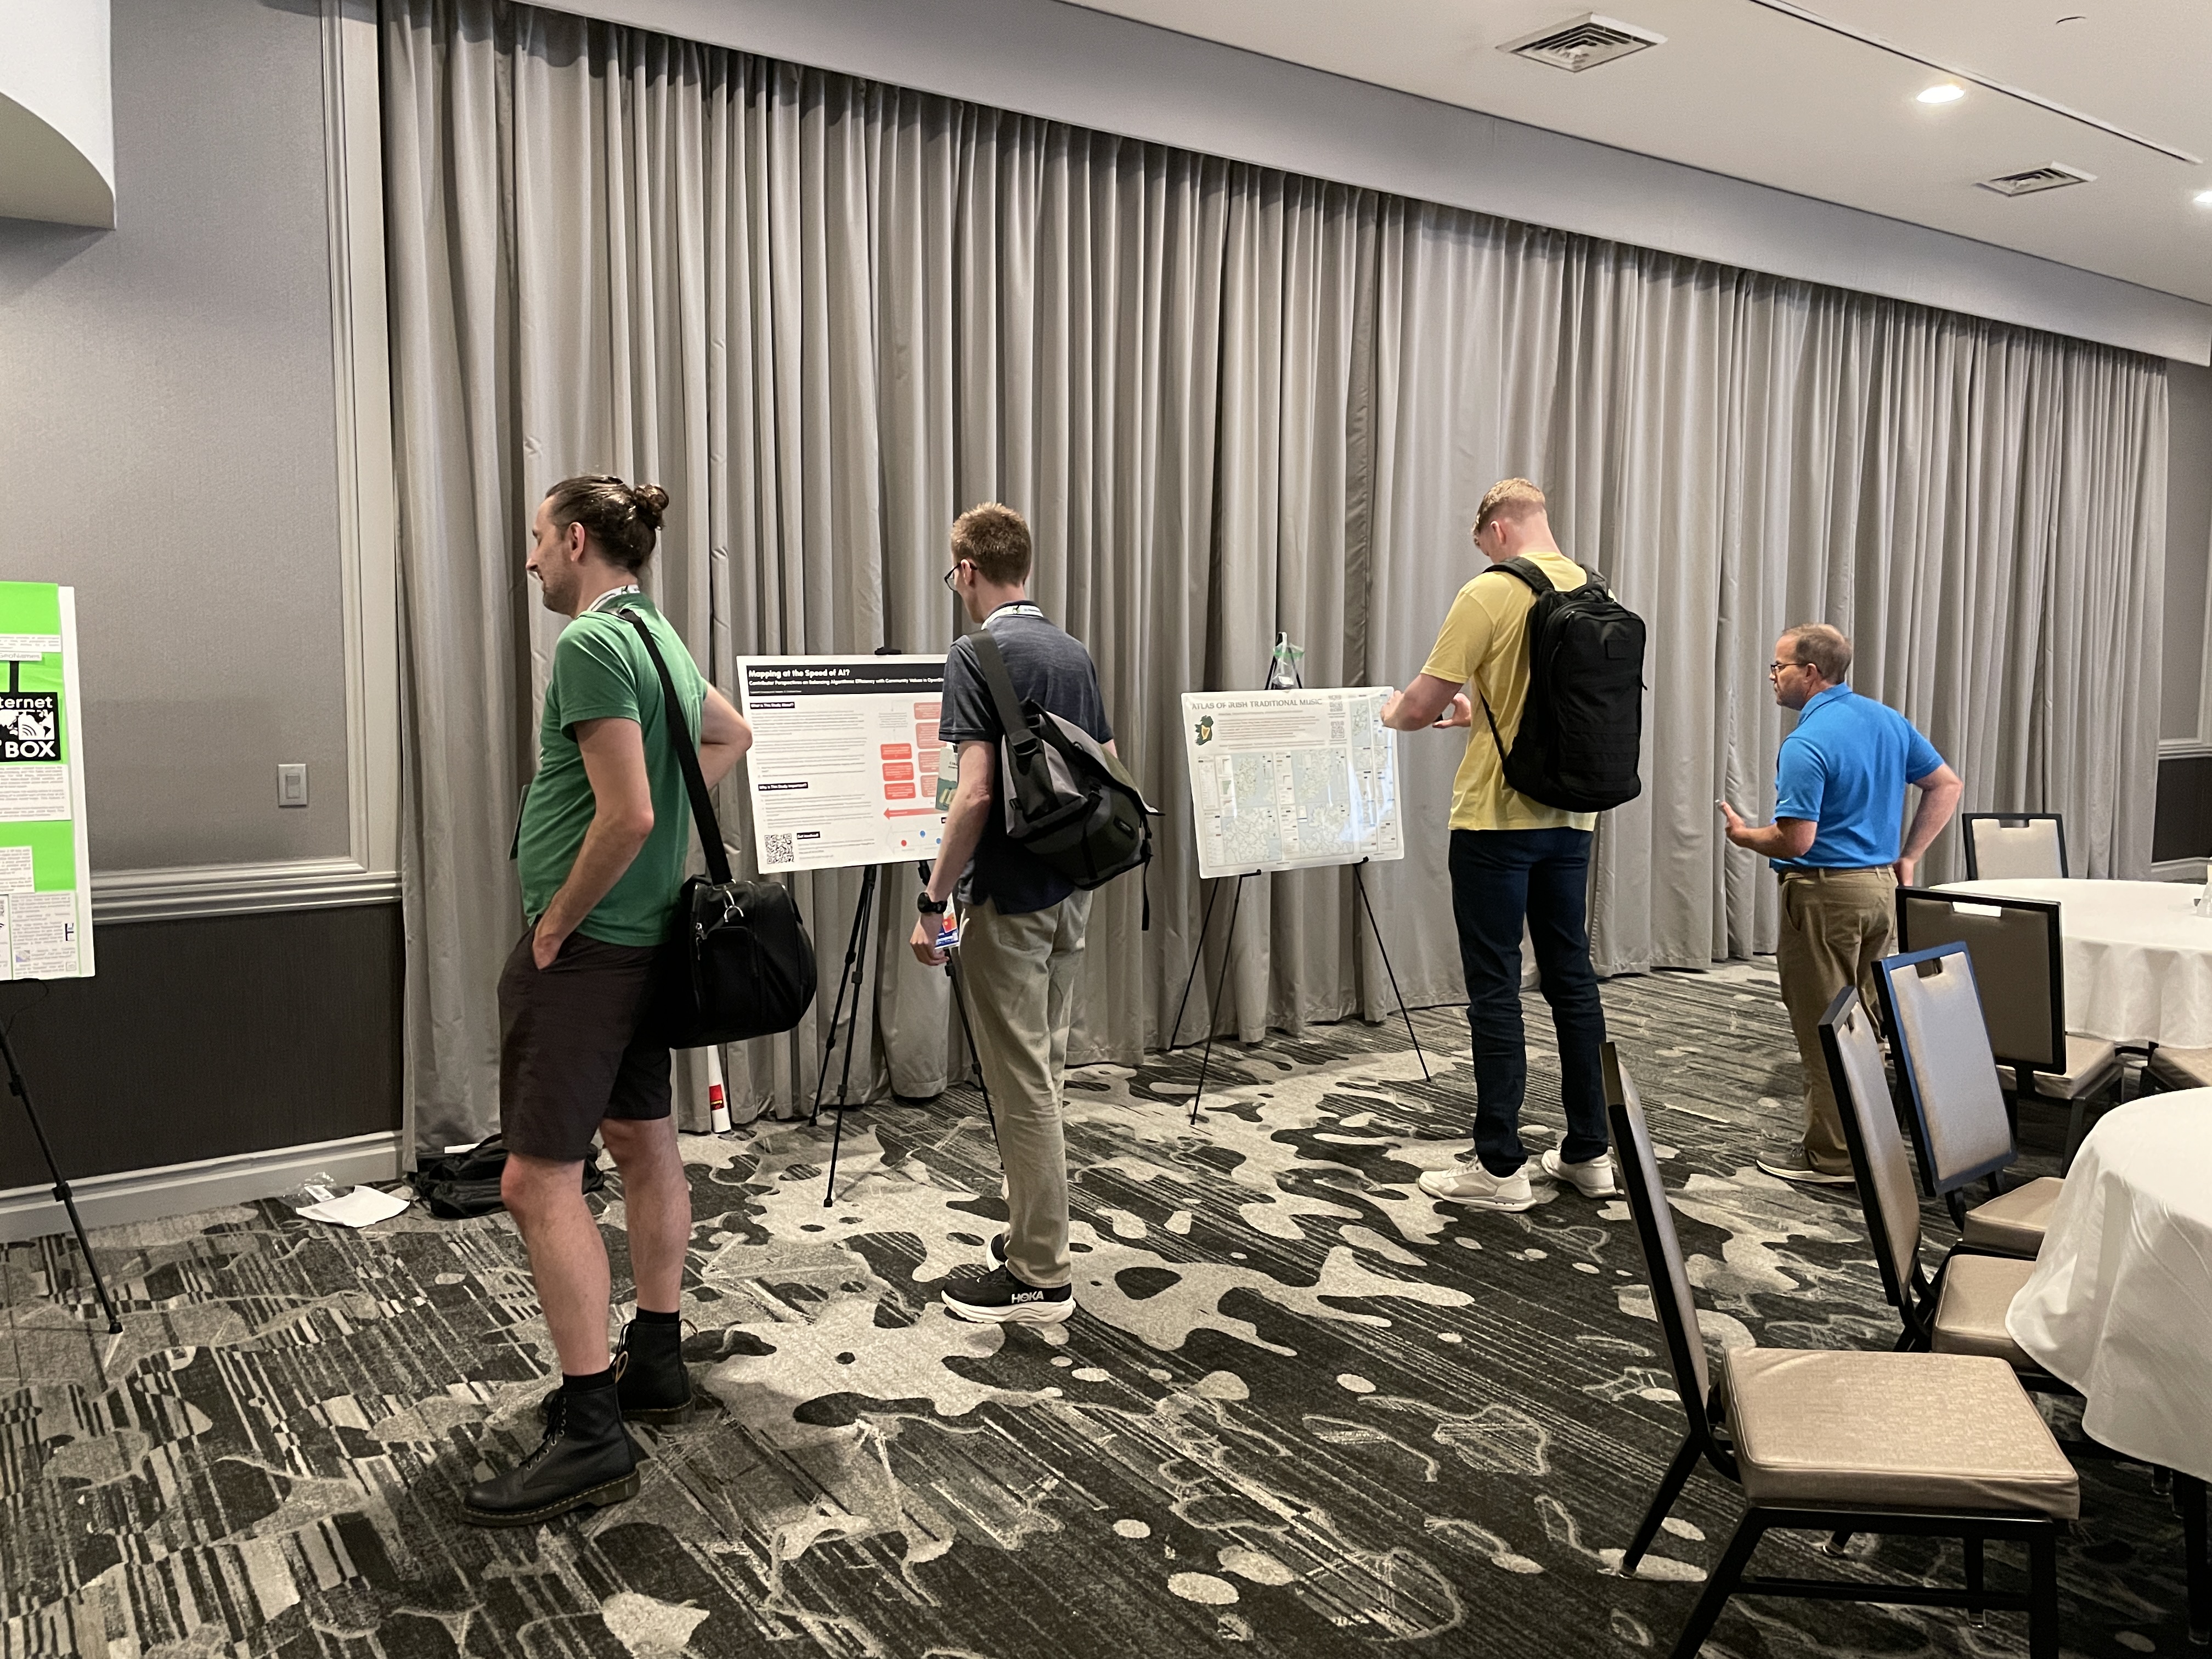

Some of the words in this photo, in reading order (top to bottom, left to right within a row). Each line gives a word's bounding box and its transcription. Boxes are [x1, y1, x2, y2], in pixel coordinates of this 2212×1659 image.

[749, 669, 782, 680] Mapping
[792, 669, 804, 677] the
[804, 669, 828, 679] Speed
[828, 668, 837, 676] of
[838, 668, 850, 676] AI?
[5, 741, 56, 758] BOX
[1011, 1290, 1044, 1304] HOKA
